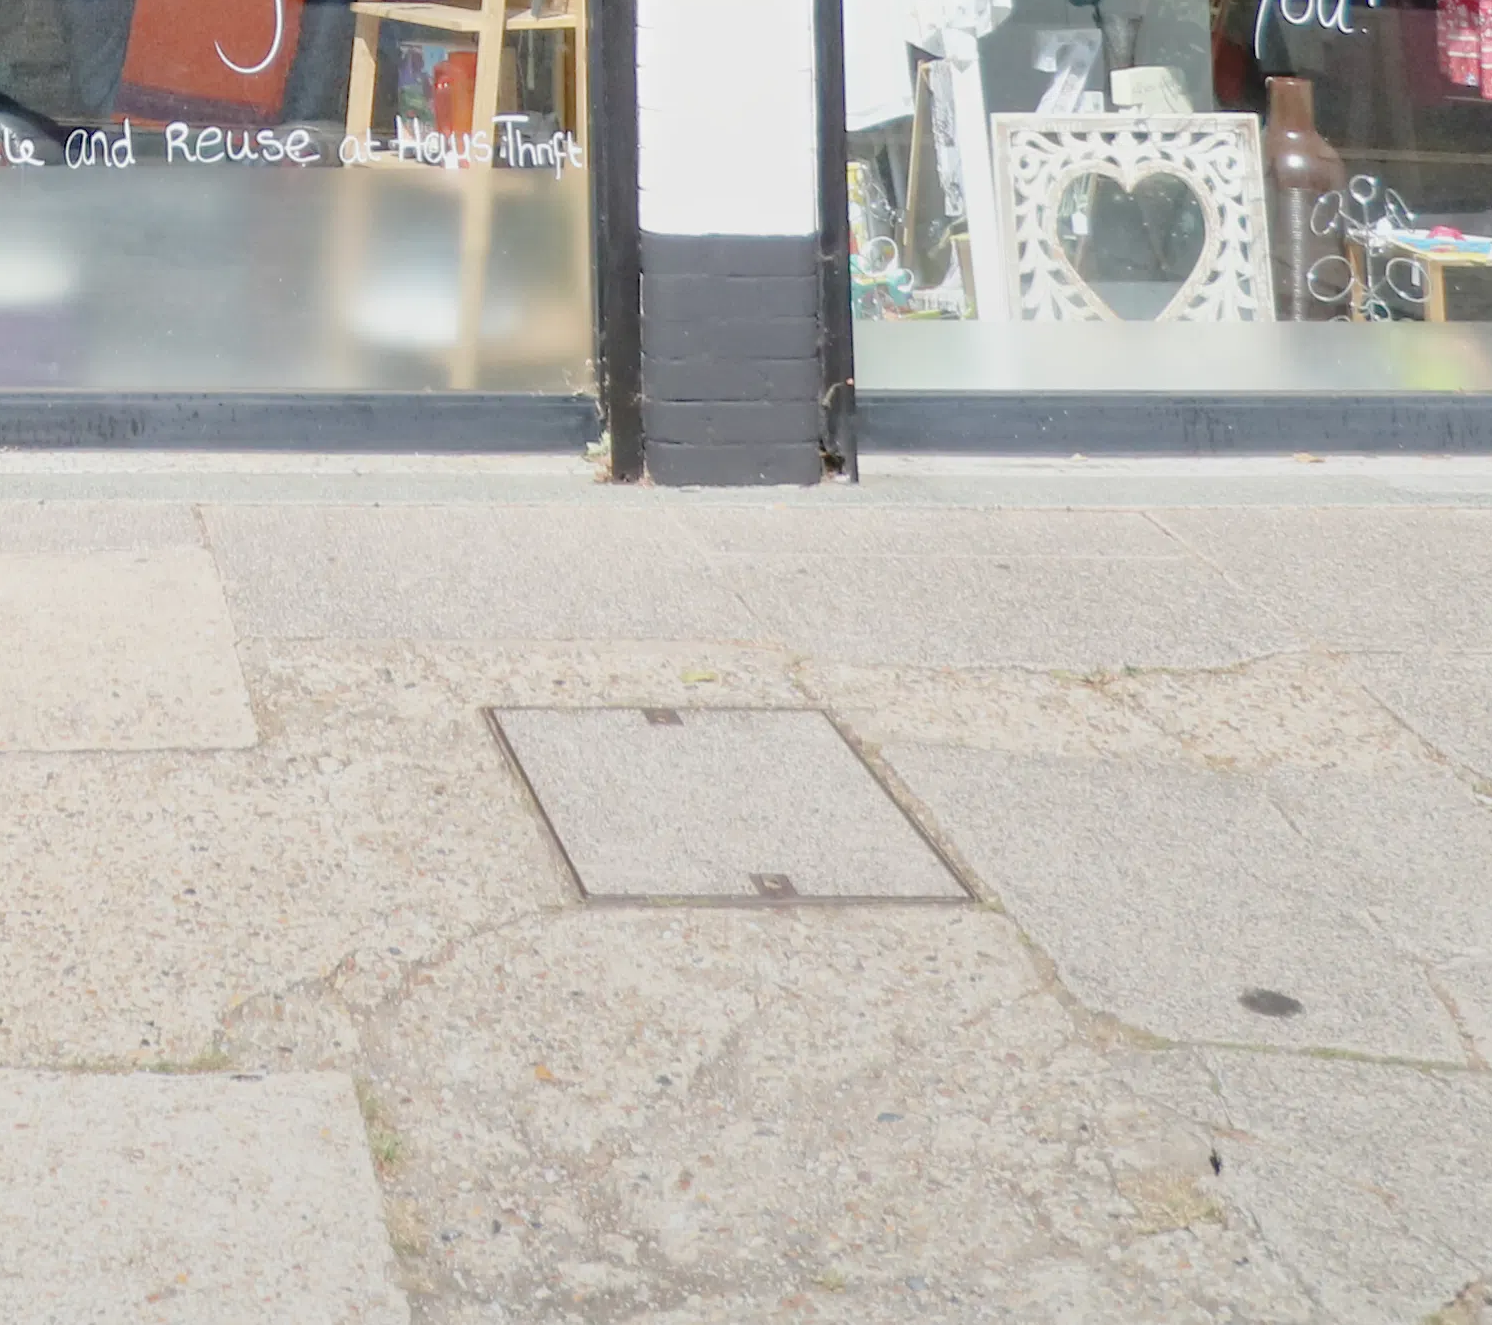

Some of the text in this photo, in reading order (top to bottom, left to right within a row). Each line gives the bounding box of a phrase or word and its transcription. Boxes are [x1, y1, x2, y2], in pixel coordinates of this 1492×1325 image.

[65, 118, 135, 169] and
[166, 120, 316, 165] Reuse
[339, 126, 382, 164] at
[390, 114, 492, 166] Haus
[492, 113, 583, 181] Thrift
